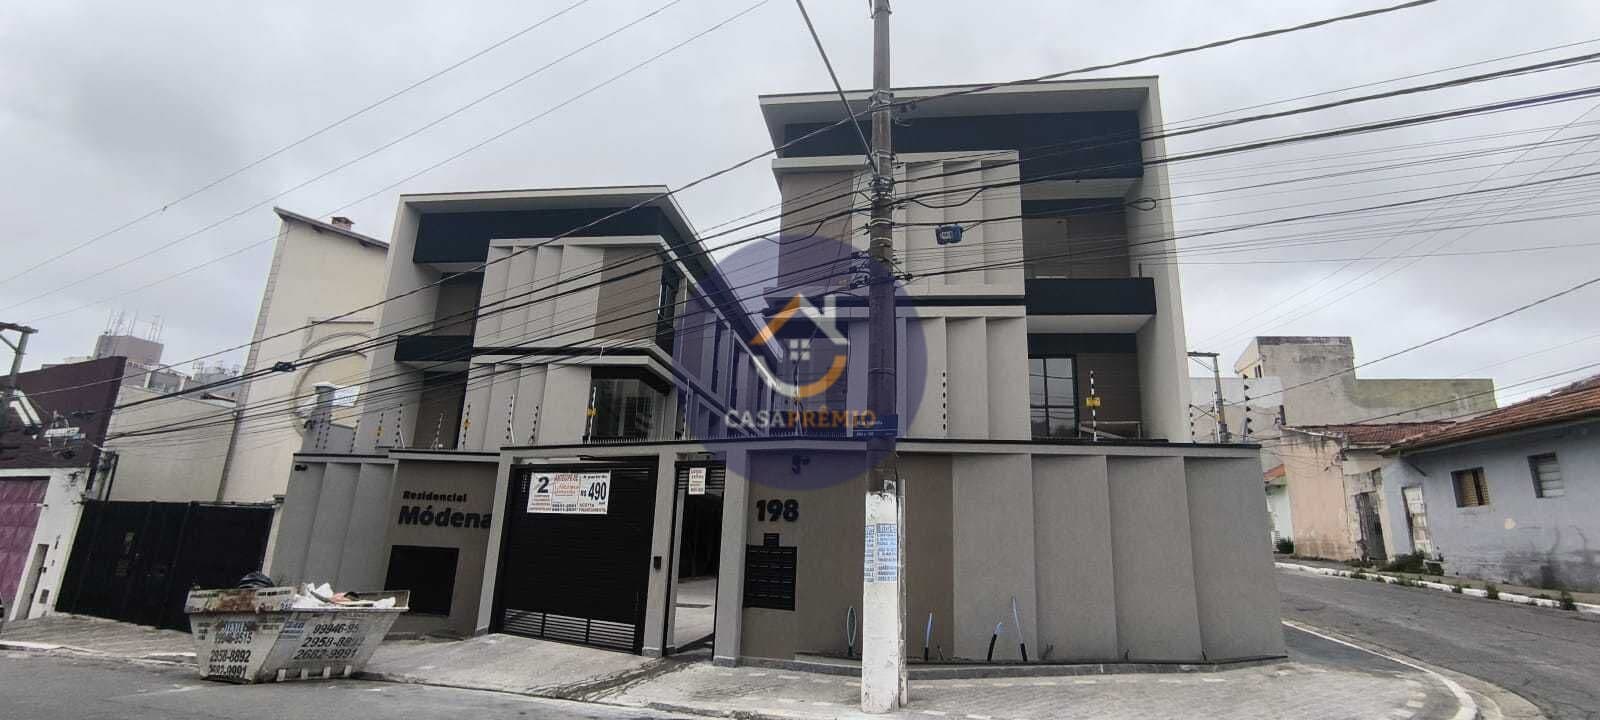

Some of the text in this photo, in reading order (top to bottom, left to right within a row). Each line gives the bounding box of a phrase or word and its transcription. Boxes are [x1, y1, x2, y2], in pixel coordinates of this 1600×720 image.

[537, 476, 550, 493] 2
[588, 481, 607, 501] 490
[402, 490, 468, 503] Residencial
[398, 505, 493, 529] Módena
[756, 499, 800, 523] 198
